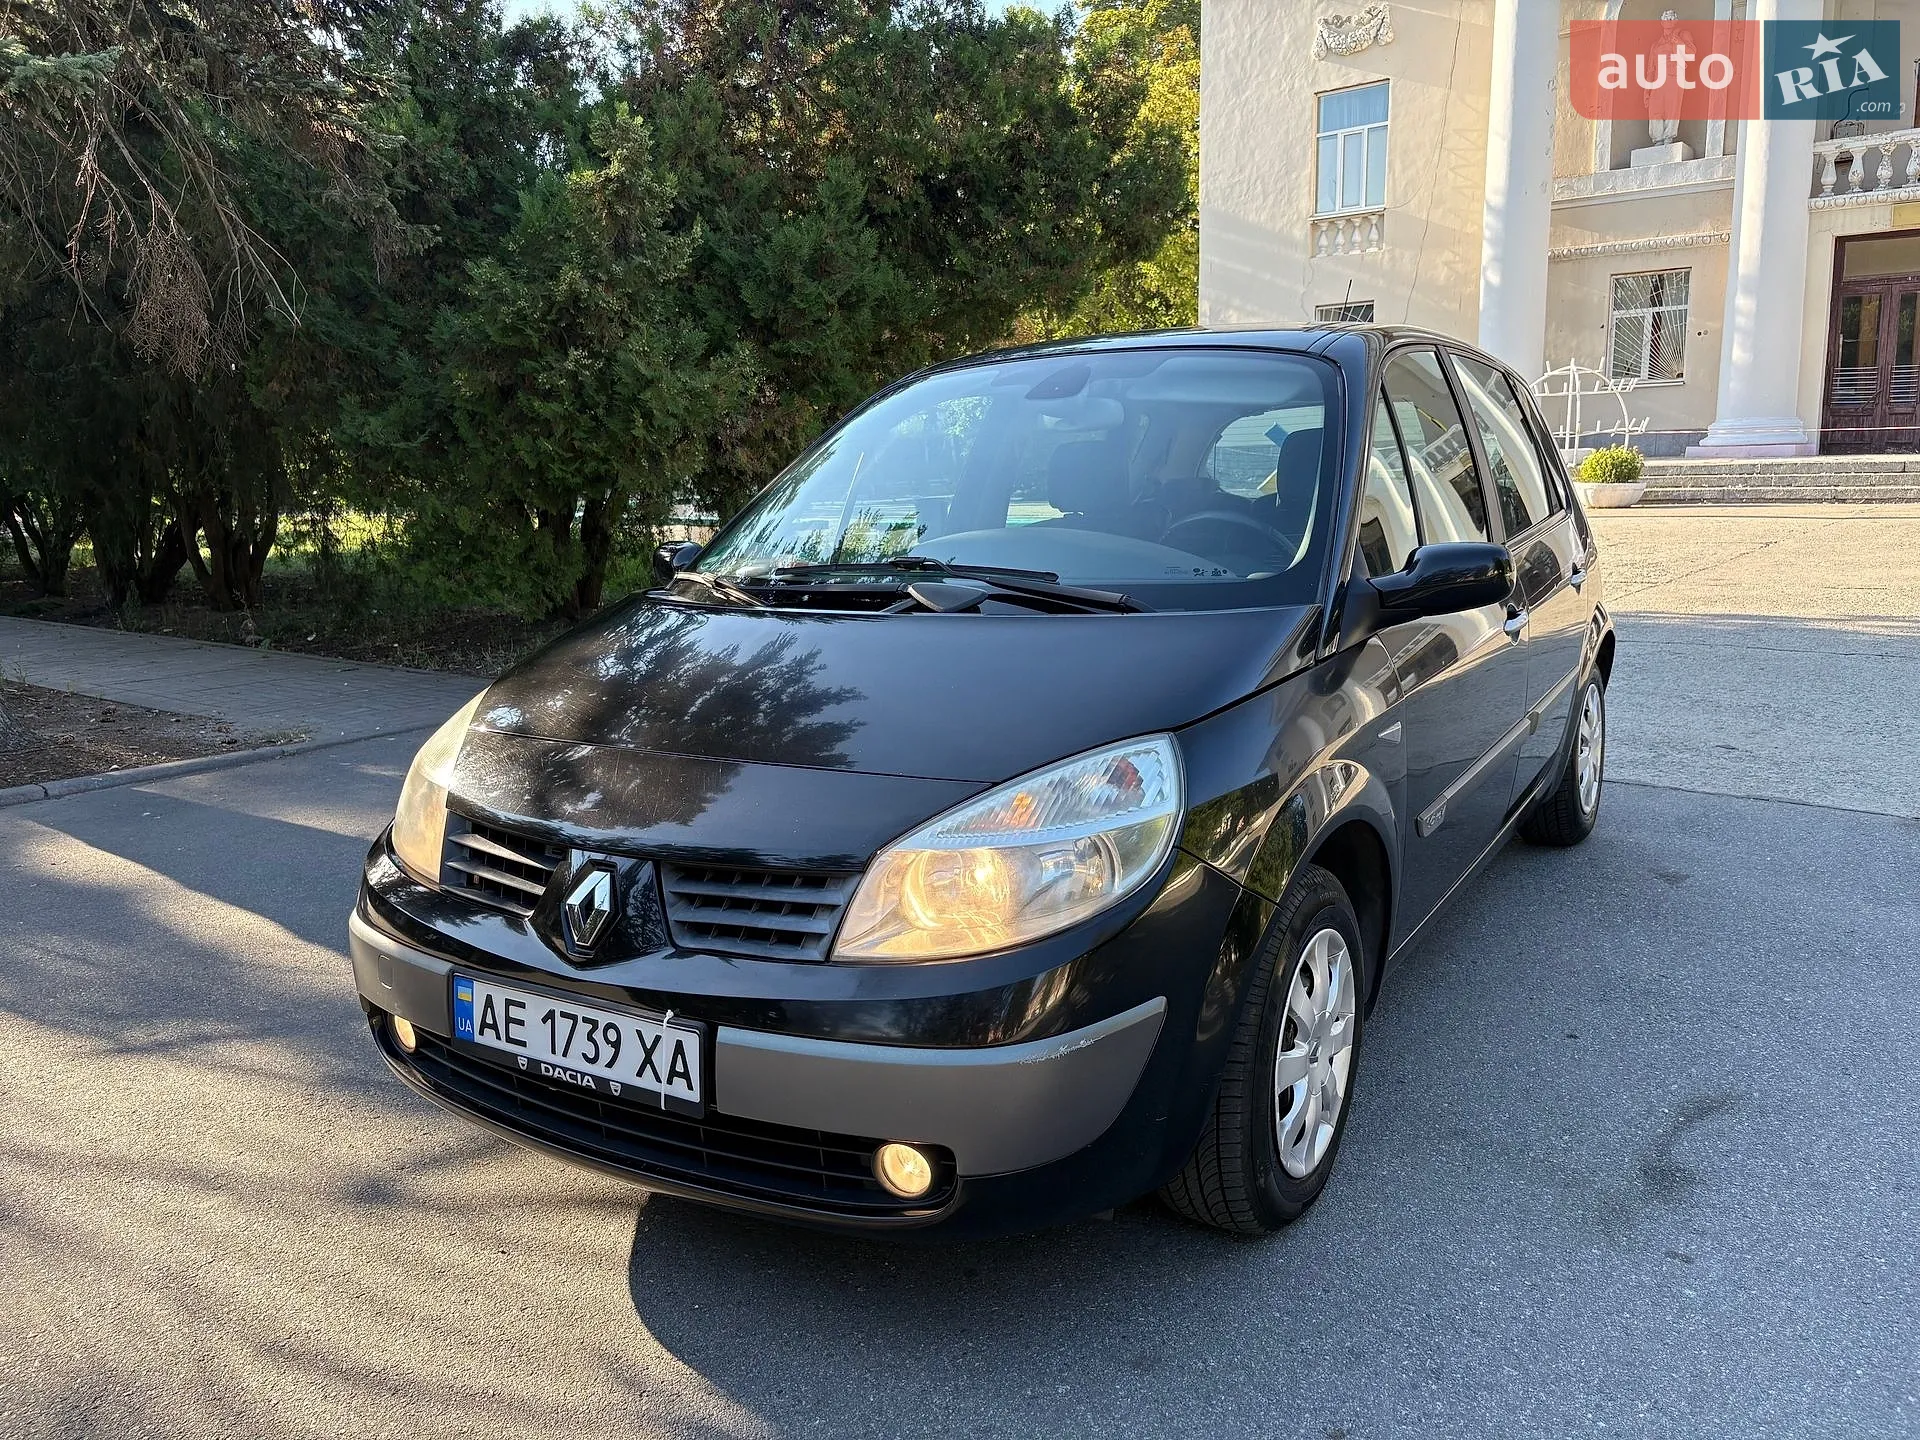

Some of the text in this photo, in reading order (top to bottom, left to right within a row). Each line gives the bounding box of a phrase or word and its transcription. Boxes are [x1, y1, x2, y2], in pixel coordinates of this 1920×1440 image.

[458, 1016, 473, 1034] UA
[478, 993, 694, 1092] AE 1739 XA
[540, 1062, 597, 1090] DACIA
